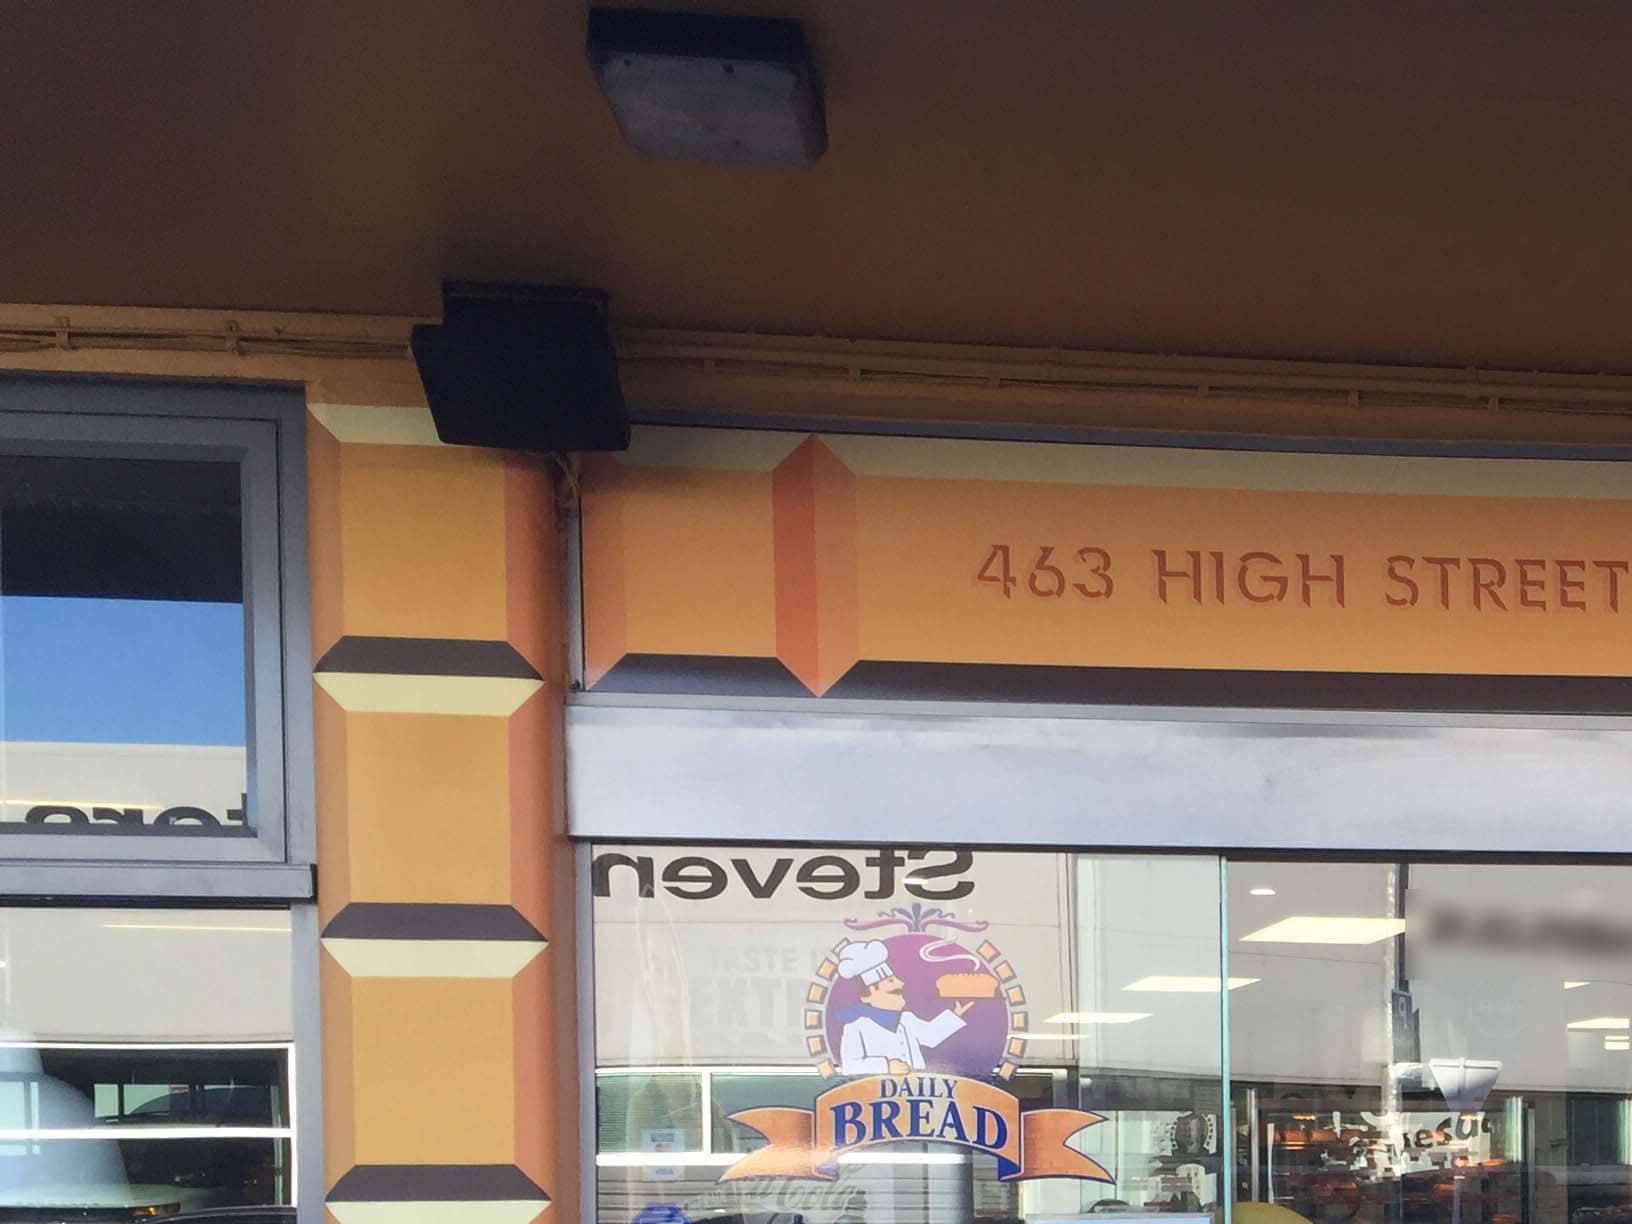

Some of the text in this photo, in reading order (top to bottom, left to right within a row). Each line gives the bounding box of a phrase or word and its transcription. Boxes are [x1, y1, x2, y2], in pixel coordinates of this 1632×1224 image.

[976, 544, 1629, 613] 463 HIGH STREET
[880, 1077, 960, 1099] DAILY
[829, 1099, 1009, 1150] BREAD
